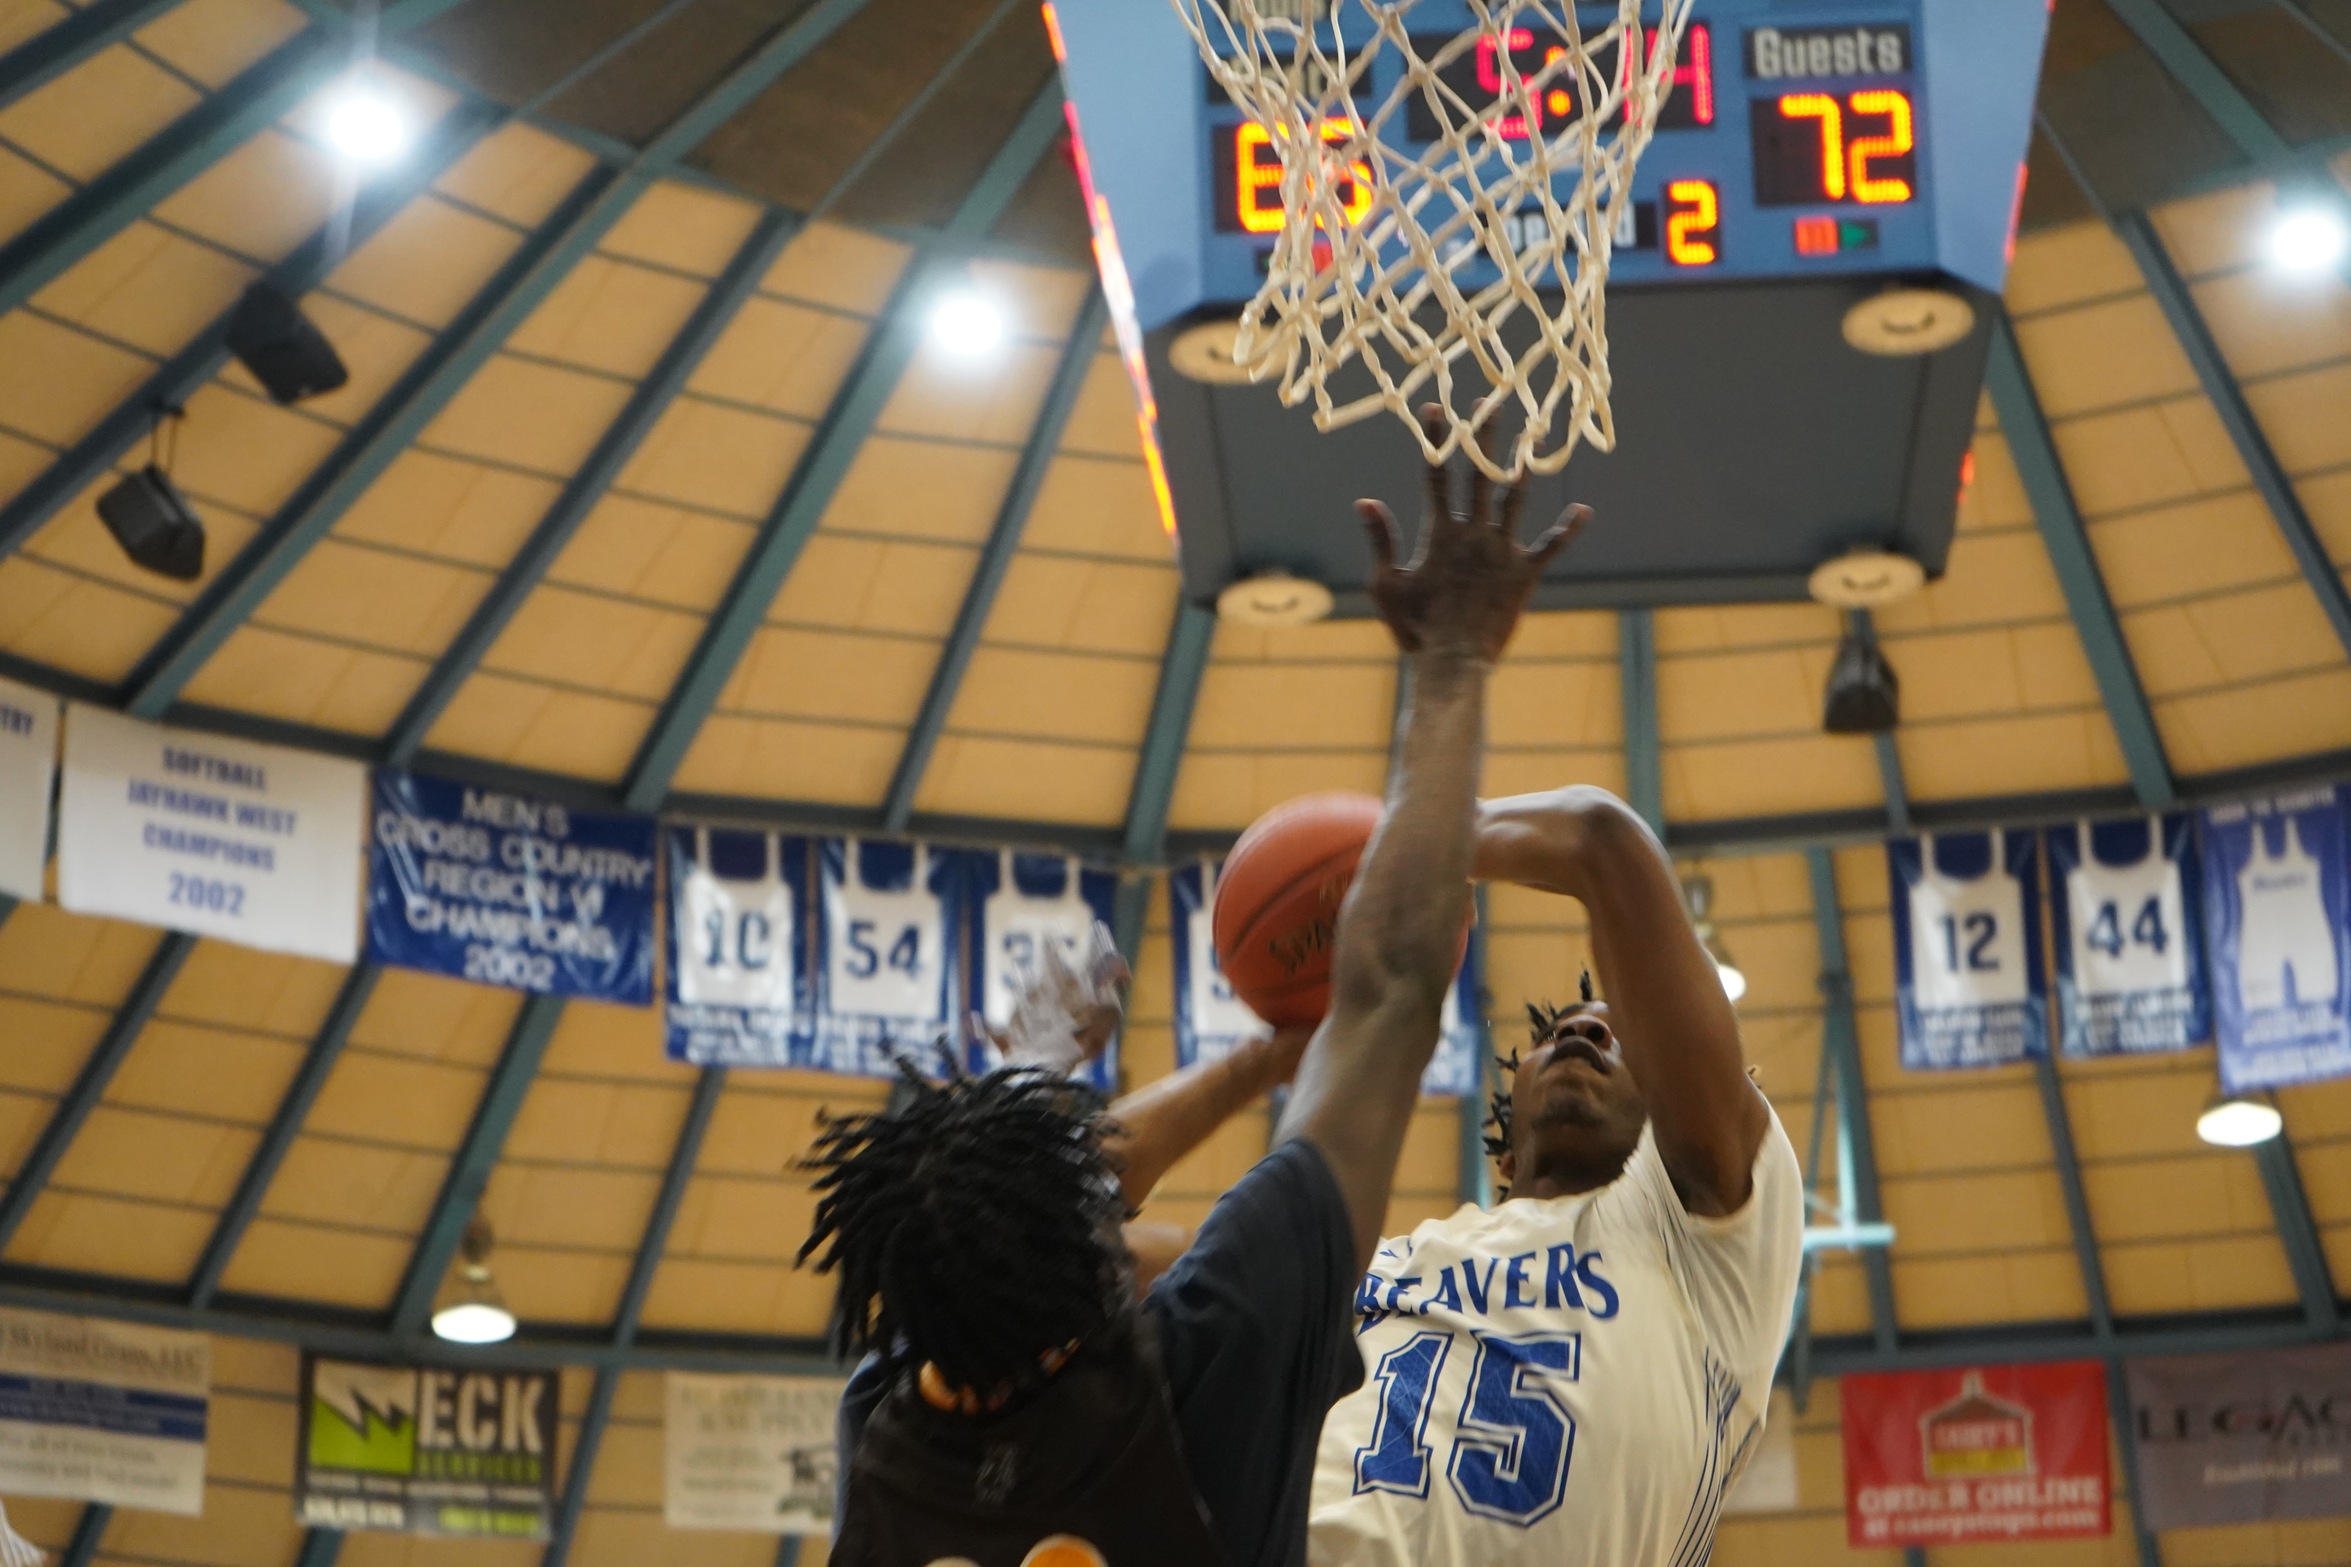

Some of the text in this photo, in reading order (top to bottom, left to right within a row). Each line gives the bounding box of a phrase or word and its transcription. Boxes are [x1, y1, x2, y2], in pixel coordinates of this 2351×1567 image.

[1754, 28, 1903, 79] Guests
[1779, 90, 1914, 204] 72
[1667, 180, 1718, 266] 2
[162, 746, 266, 791] SOFTBALL
[127, 776, 297, 837] JAYHAWK WEST
[142, 821, 276, 872] CHAMPIONS
[377, 811, 652, 890] CROSS COUNTRY
[168, 872, 246, 917] 2002
[423, 858, 560, 912] REGION
[846, 920, 923, 979] 54
[1941, 910, 2001, 972] 12
[2087, 896, 2169, 957] 44
[463, 944, 555, 992] 2002
[1353, 1241, 1620, 1336] BEAVERS
[417, 1371, 545, 1453] ECK
[1352, 1329, 1582, 1530] 15
[1857, 1476, 2102, 1514] ORDER ONLINE
